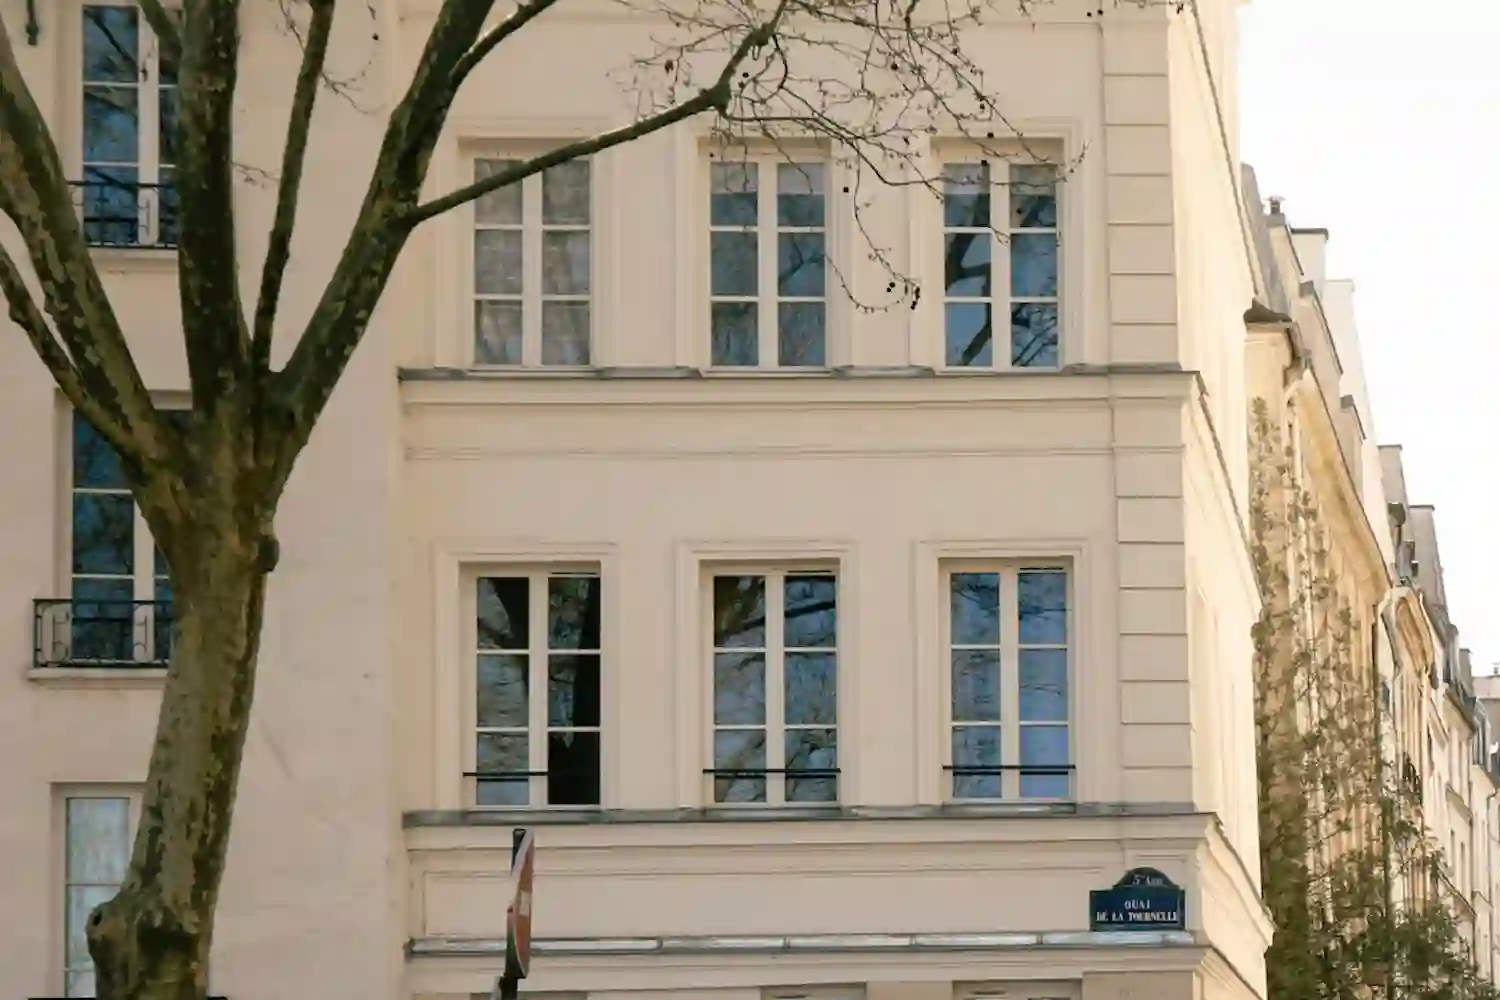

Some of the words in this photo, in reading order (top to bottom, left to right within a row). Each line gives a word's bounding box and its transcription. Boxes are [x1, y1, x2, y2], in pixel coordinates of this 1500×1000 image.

[1124, 899, 1150, 910] QUAI
[1096, 911, 1109, 921] DE
[1112, 911, 1124, 921] LA
[1128, 911, 1177, 921] TOURNELLE
